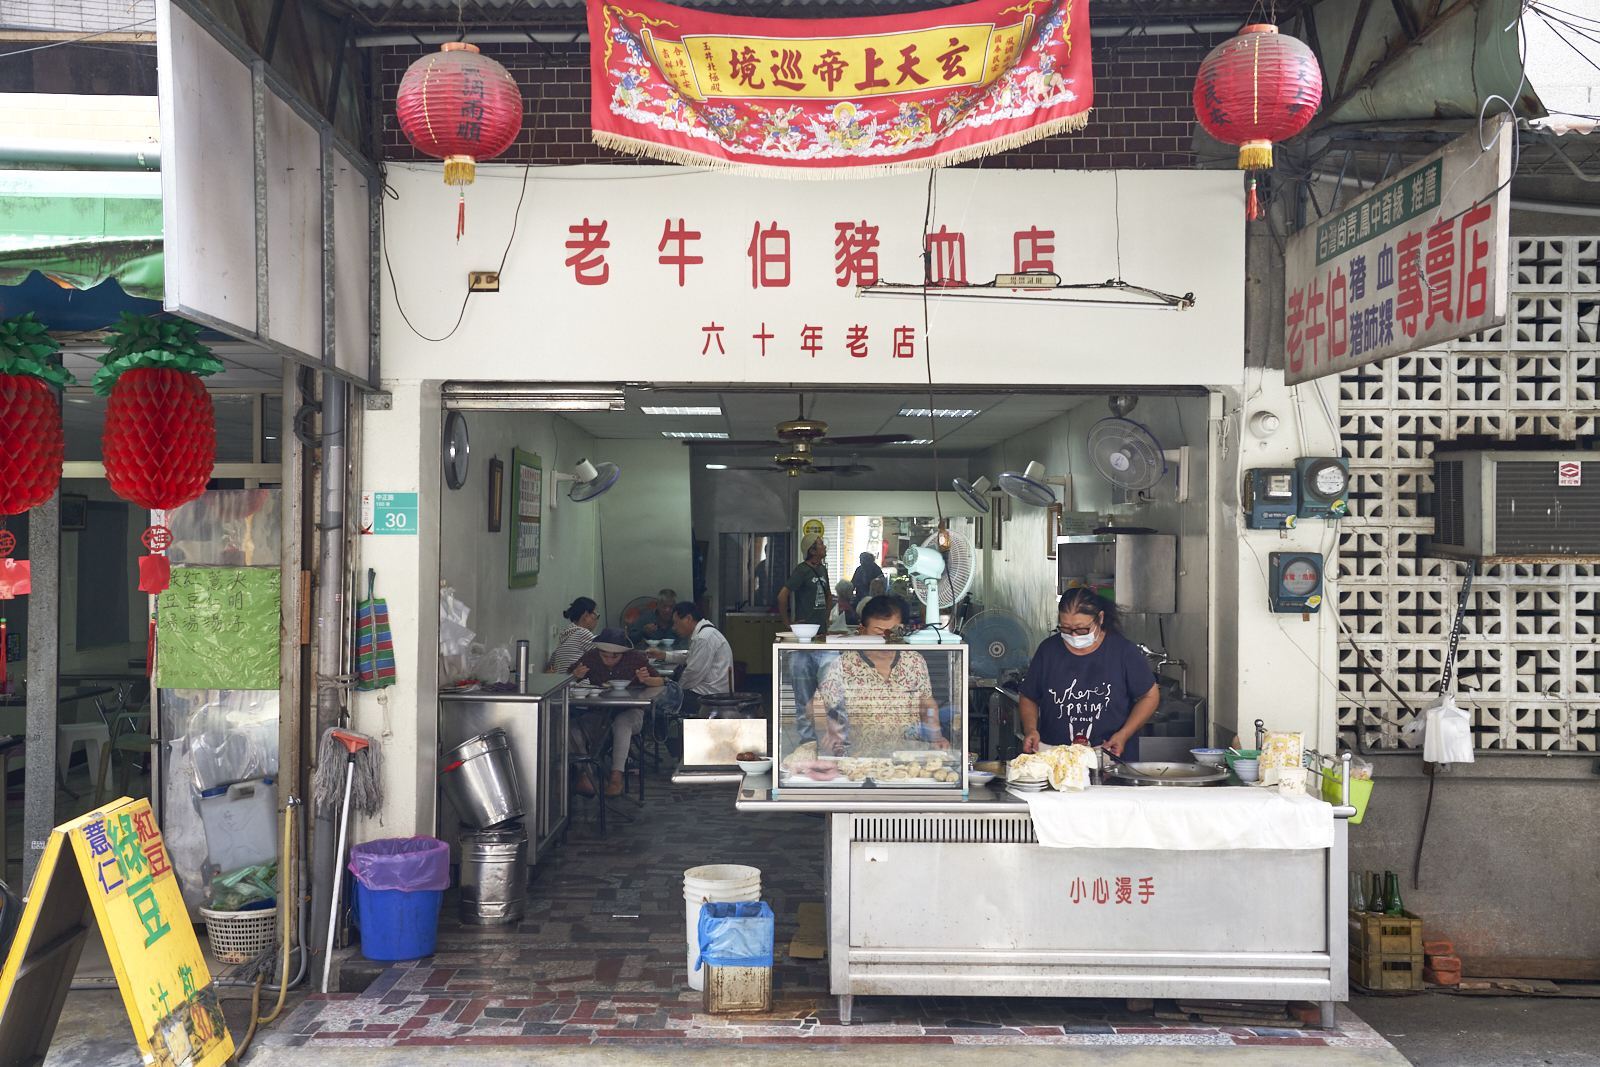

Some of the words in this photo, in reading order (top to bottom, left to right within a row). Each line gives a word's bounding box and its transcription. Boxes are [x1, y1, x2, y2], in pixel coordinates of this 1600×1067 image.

[673, 46, 692, 90] 合境平安
[702, 42, 722, 93] 玉井北極殿
[729, 37, 971, 92] 玄天上帝巡境
[1203, 52, 1232, 127] 泰民安
[1411, 166, 1437, 214] 推薦
[1396, 200, 1492, 338] 專賣店
[701, 321, 915, 359] 六十年老店
[1287, 266, 1347, 373] 老牛伯
[385, 513, 407, 528] 30
[1048, 678, 1112, 704] Where's
[83, 819, 124, 895] 薏仁
[133, 809, 171, 878] 紅豆
[107, 813, 171, 949] 綠豆
[1070, 876, 1155, 905] 小心燙手
